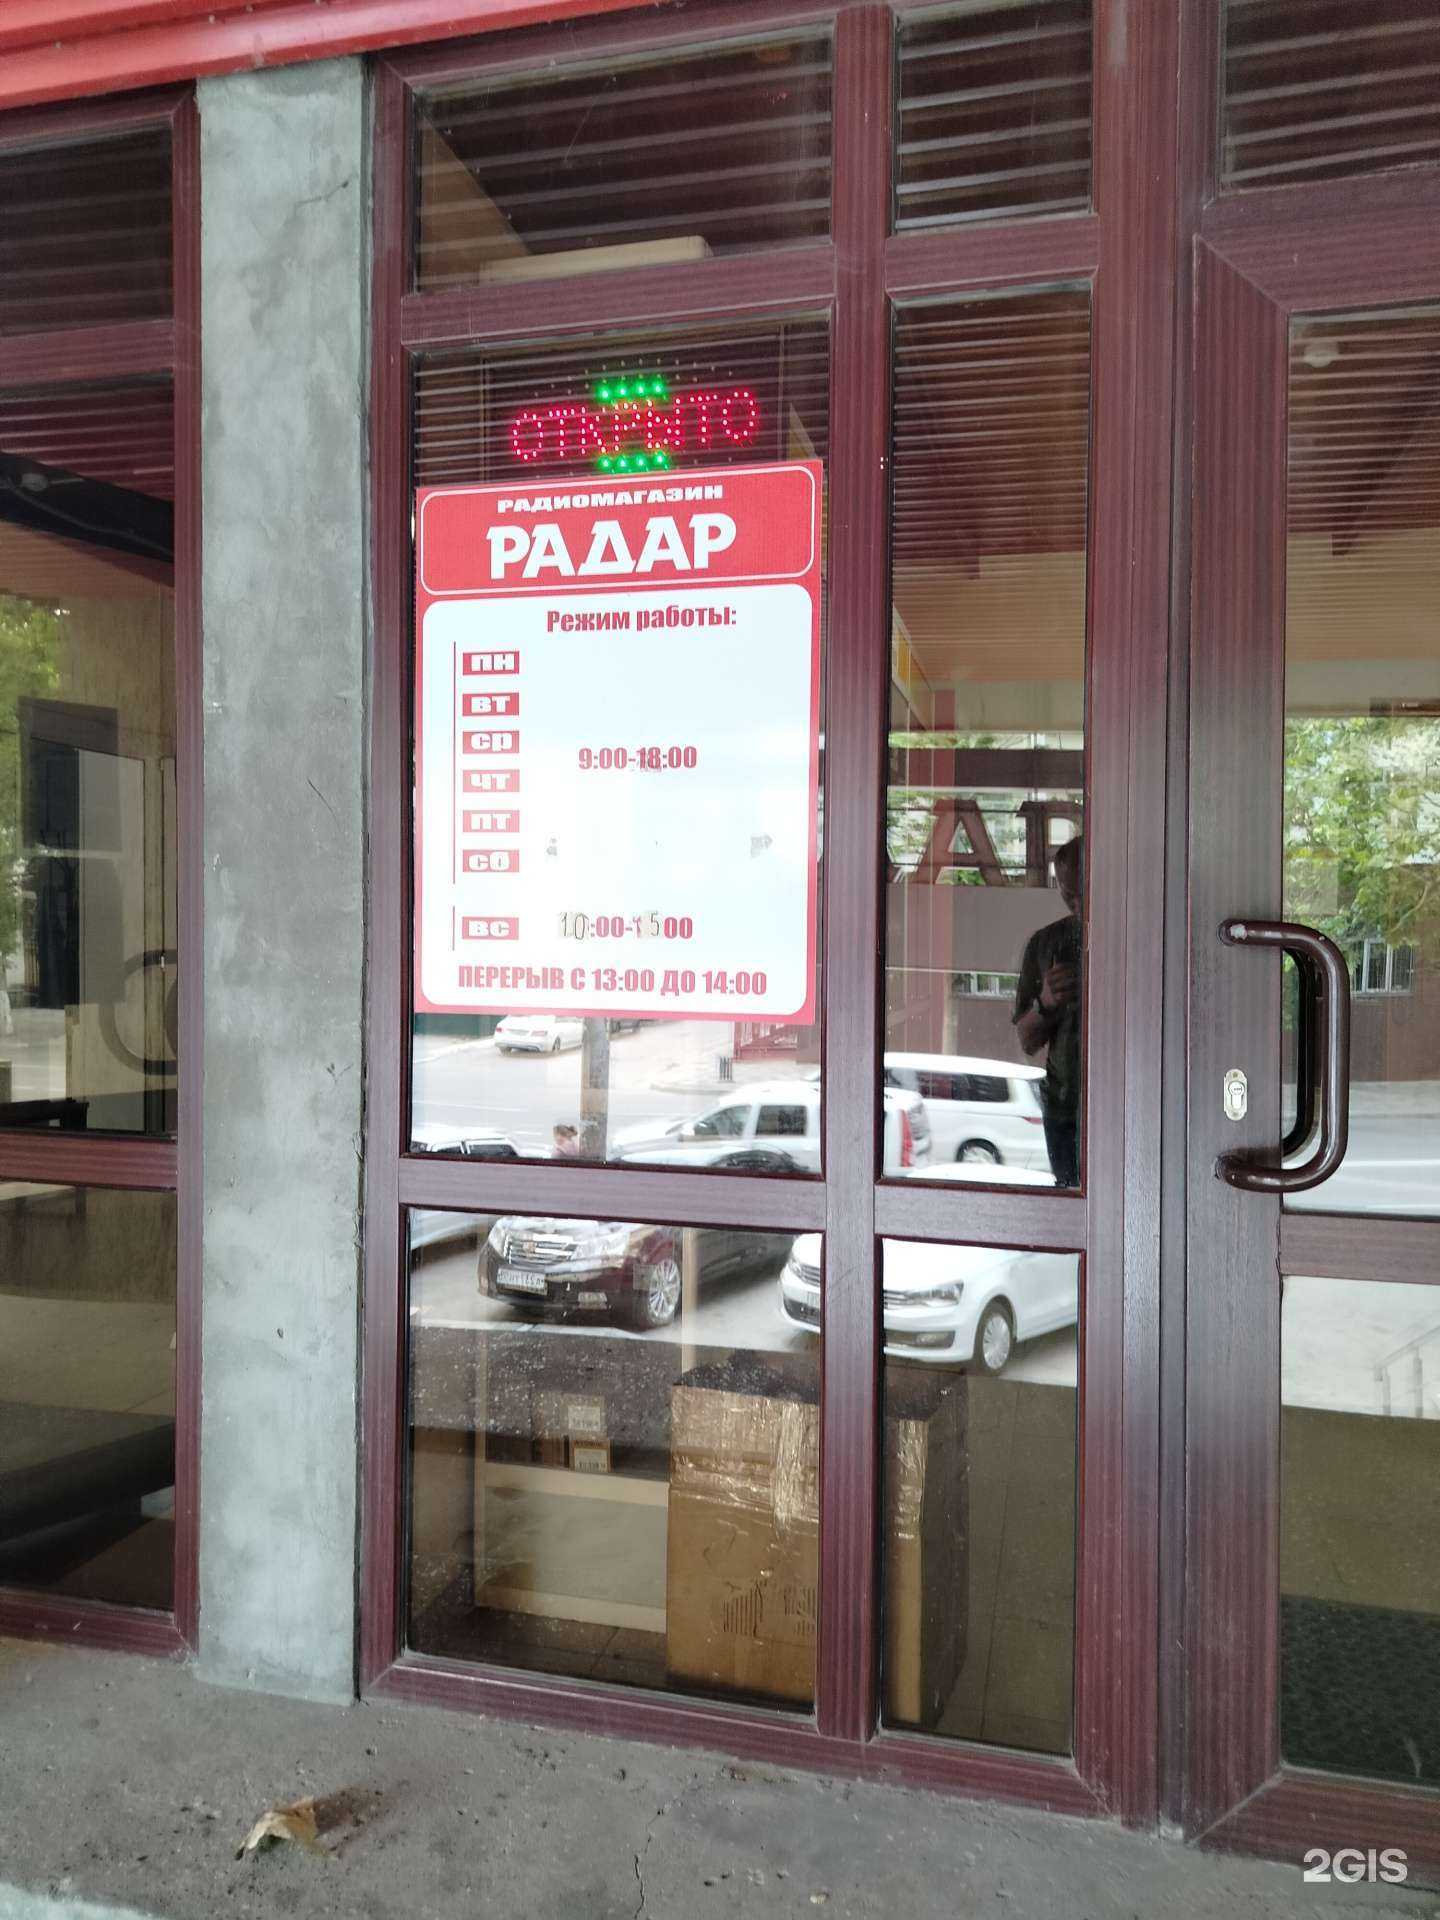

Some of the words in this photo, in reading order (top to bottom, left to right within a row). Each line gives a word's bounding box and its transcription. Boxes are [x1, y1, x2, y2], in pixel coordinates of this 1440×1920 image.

[511, 390, 757, 461] ОТКРЫТО
[497, 484, 724, 514] РАДИОМАГАЗИН
[485, 512, 738, 580] РАДАР
[546, 609, 631, 633] Режим
[636, 604, 738, 632] работы:
[578, 745, 698, 772] 9:00-18:00
[458, 965, 565, 990] ПЕРЕРЫВ
[570, 967, 586, 991] С
[591, 968, 655, 992] 13:00
[660, 970, 696, 997] ДО
[702, 970, 768, 996] 14:00
